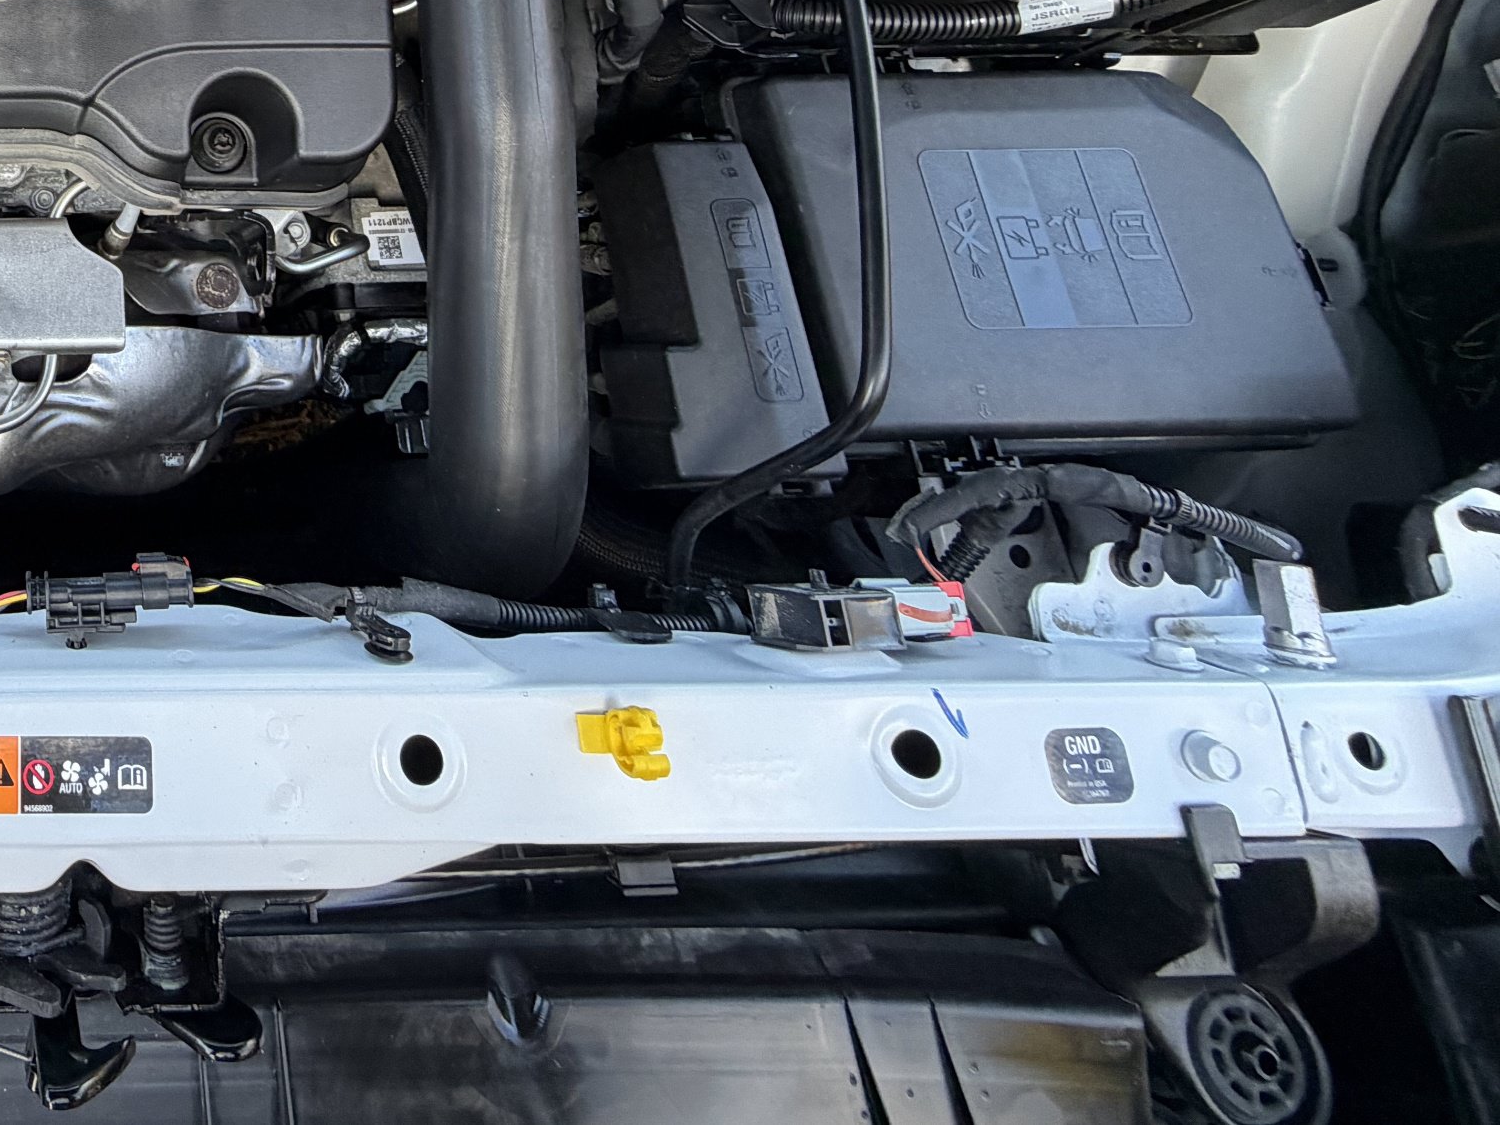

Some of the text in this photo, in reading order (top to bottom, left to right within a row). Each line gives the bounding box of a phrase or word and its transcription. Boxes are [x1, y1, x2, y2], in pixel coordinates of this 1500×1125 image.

[368, 217, 411, 227] WCBP1211
[1064, 735, 1101, 755] GND
[59, 782, 83, 794] AUTO
